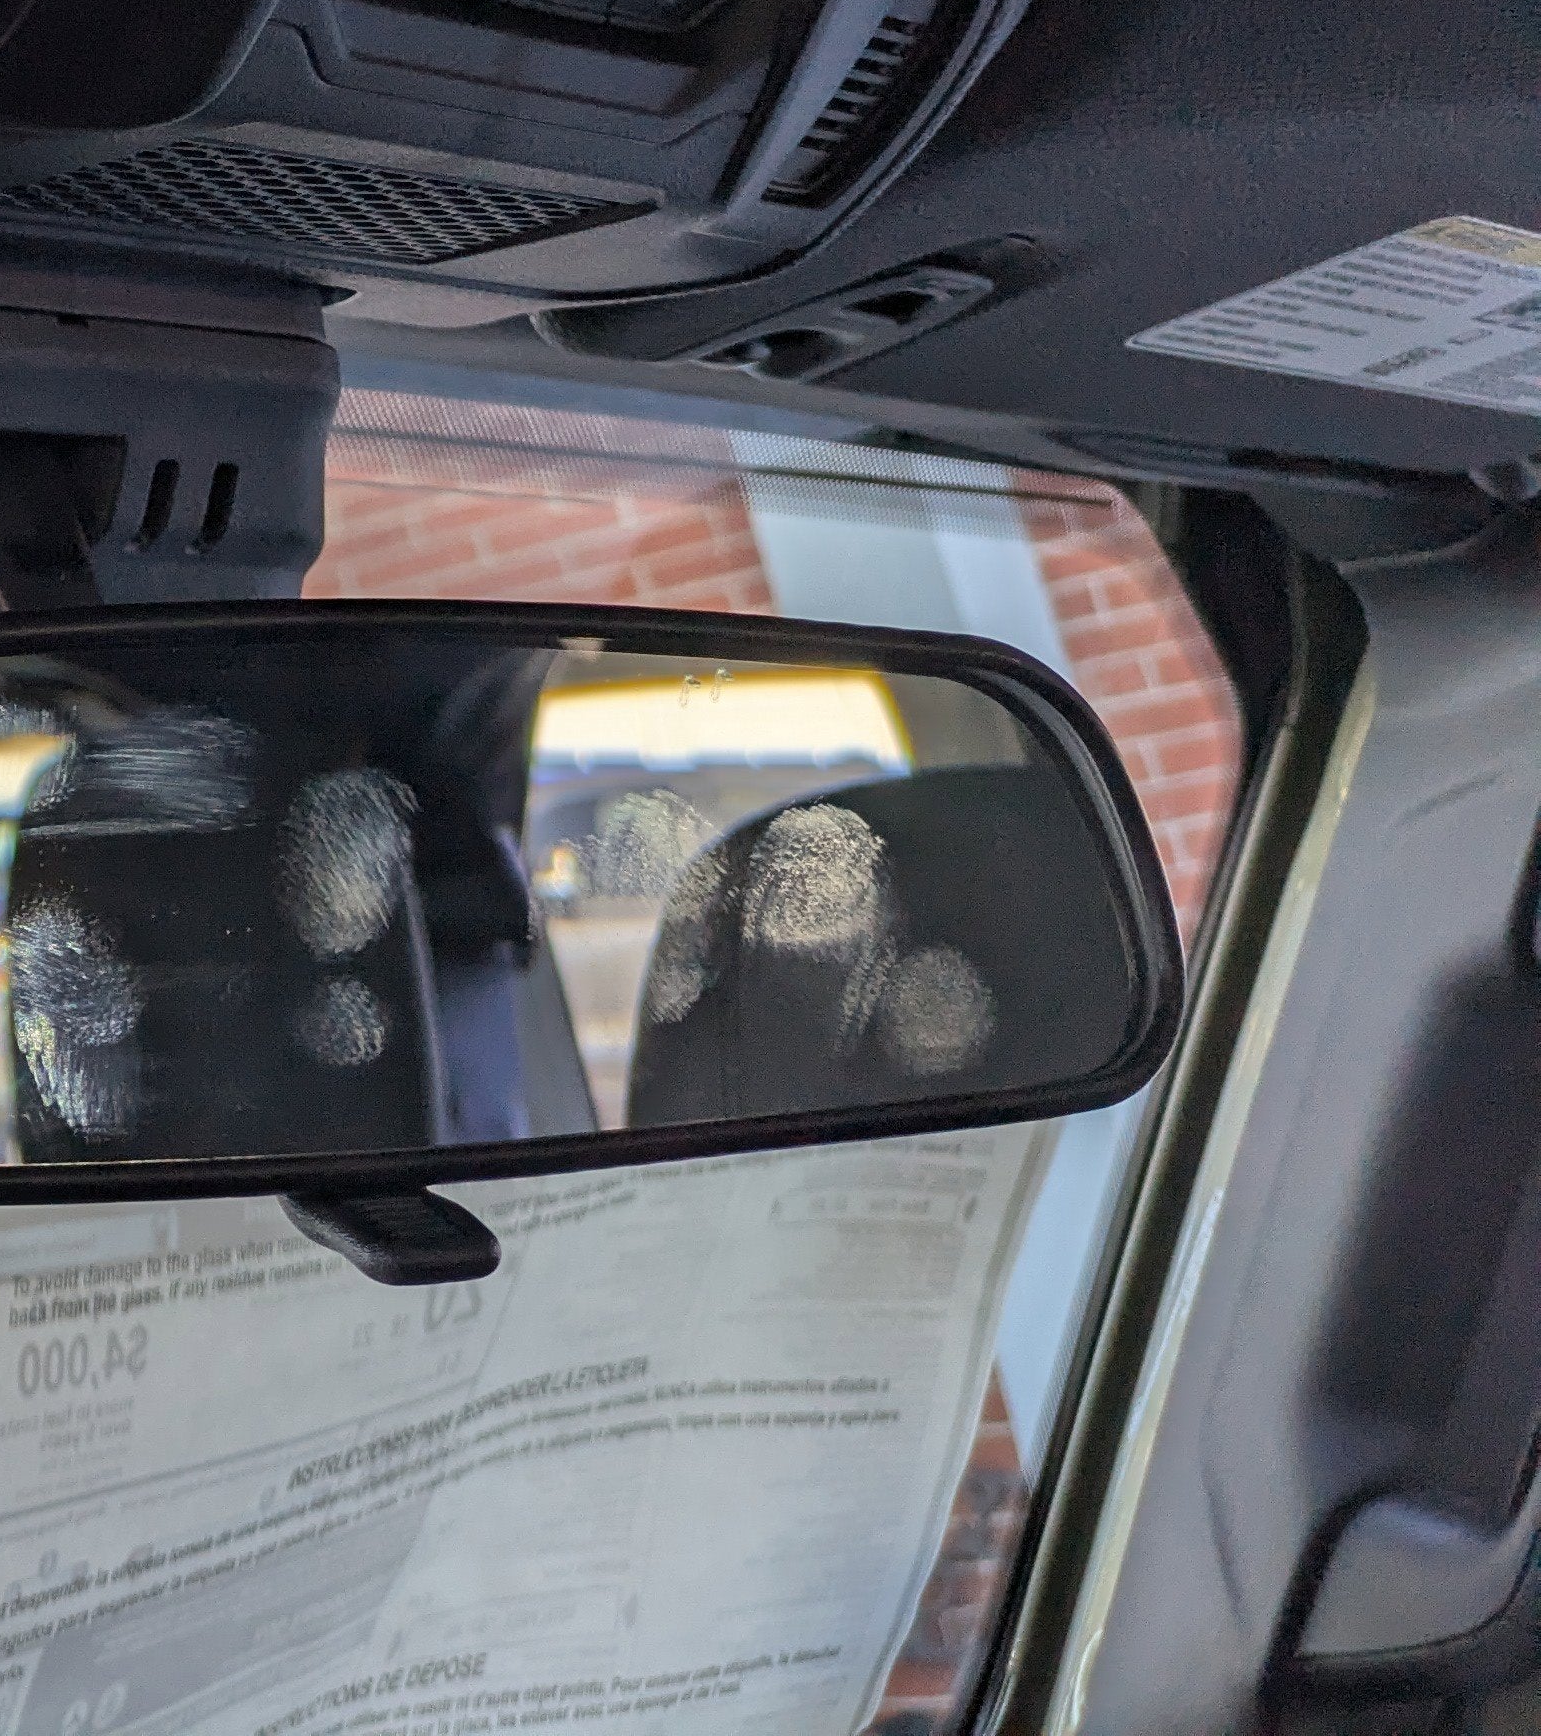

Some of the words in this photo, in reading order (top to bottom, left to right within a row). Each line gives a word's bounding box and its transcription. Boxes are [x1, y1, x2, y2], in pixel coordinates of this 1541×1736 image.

[13, 1274, 30, 1298] To
[34, 1268, 80, 1294] avoid
[83, 1259, 143, 1289] damage
[146, 1255, 162, 1277] to
[165, 1250, 191, 1274] the
[193, 1246, 232, 1275] glass
[236, 1240, 274, 1262] when
[8, 1303, 48, 1329] back
[51, 1294, 90, 1321] from
[93, 1290, 117, 1319] the
